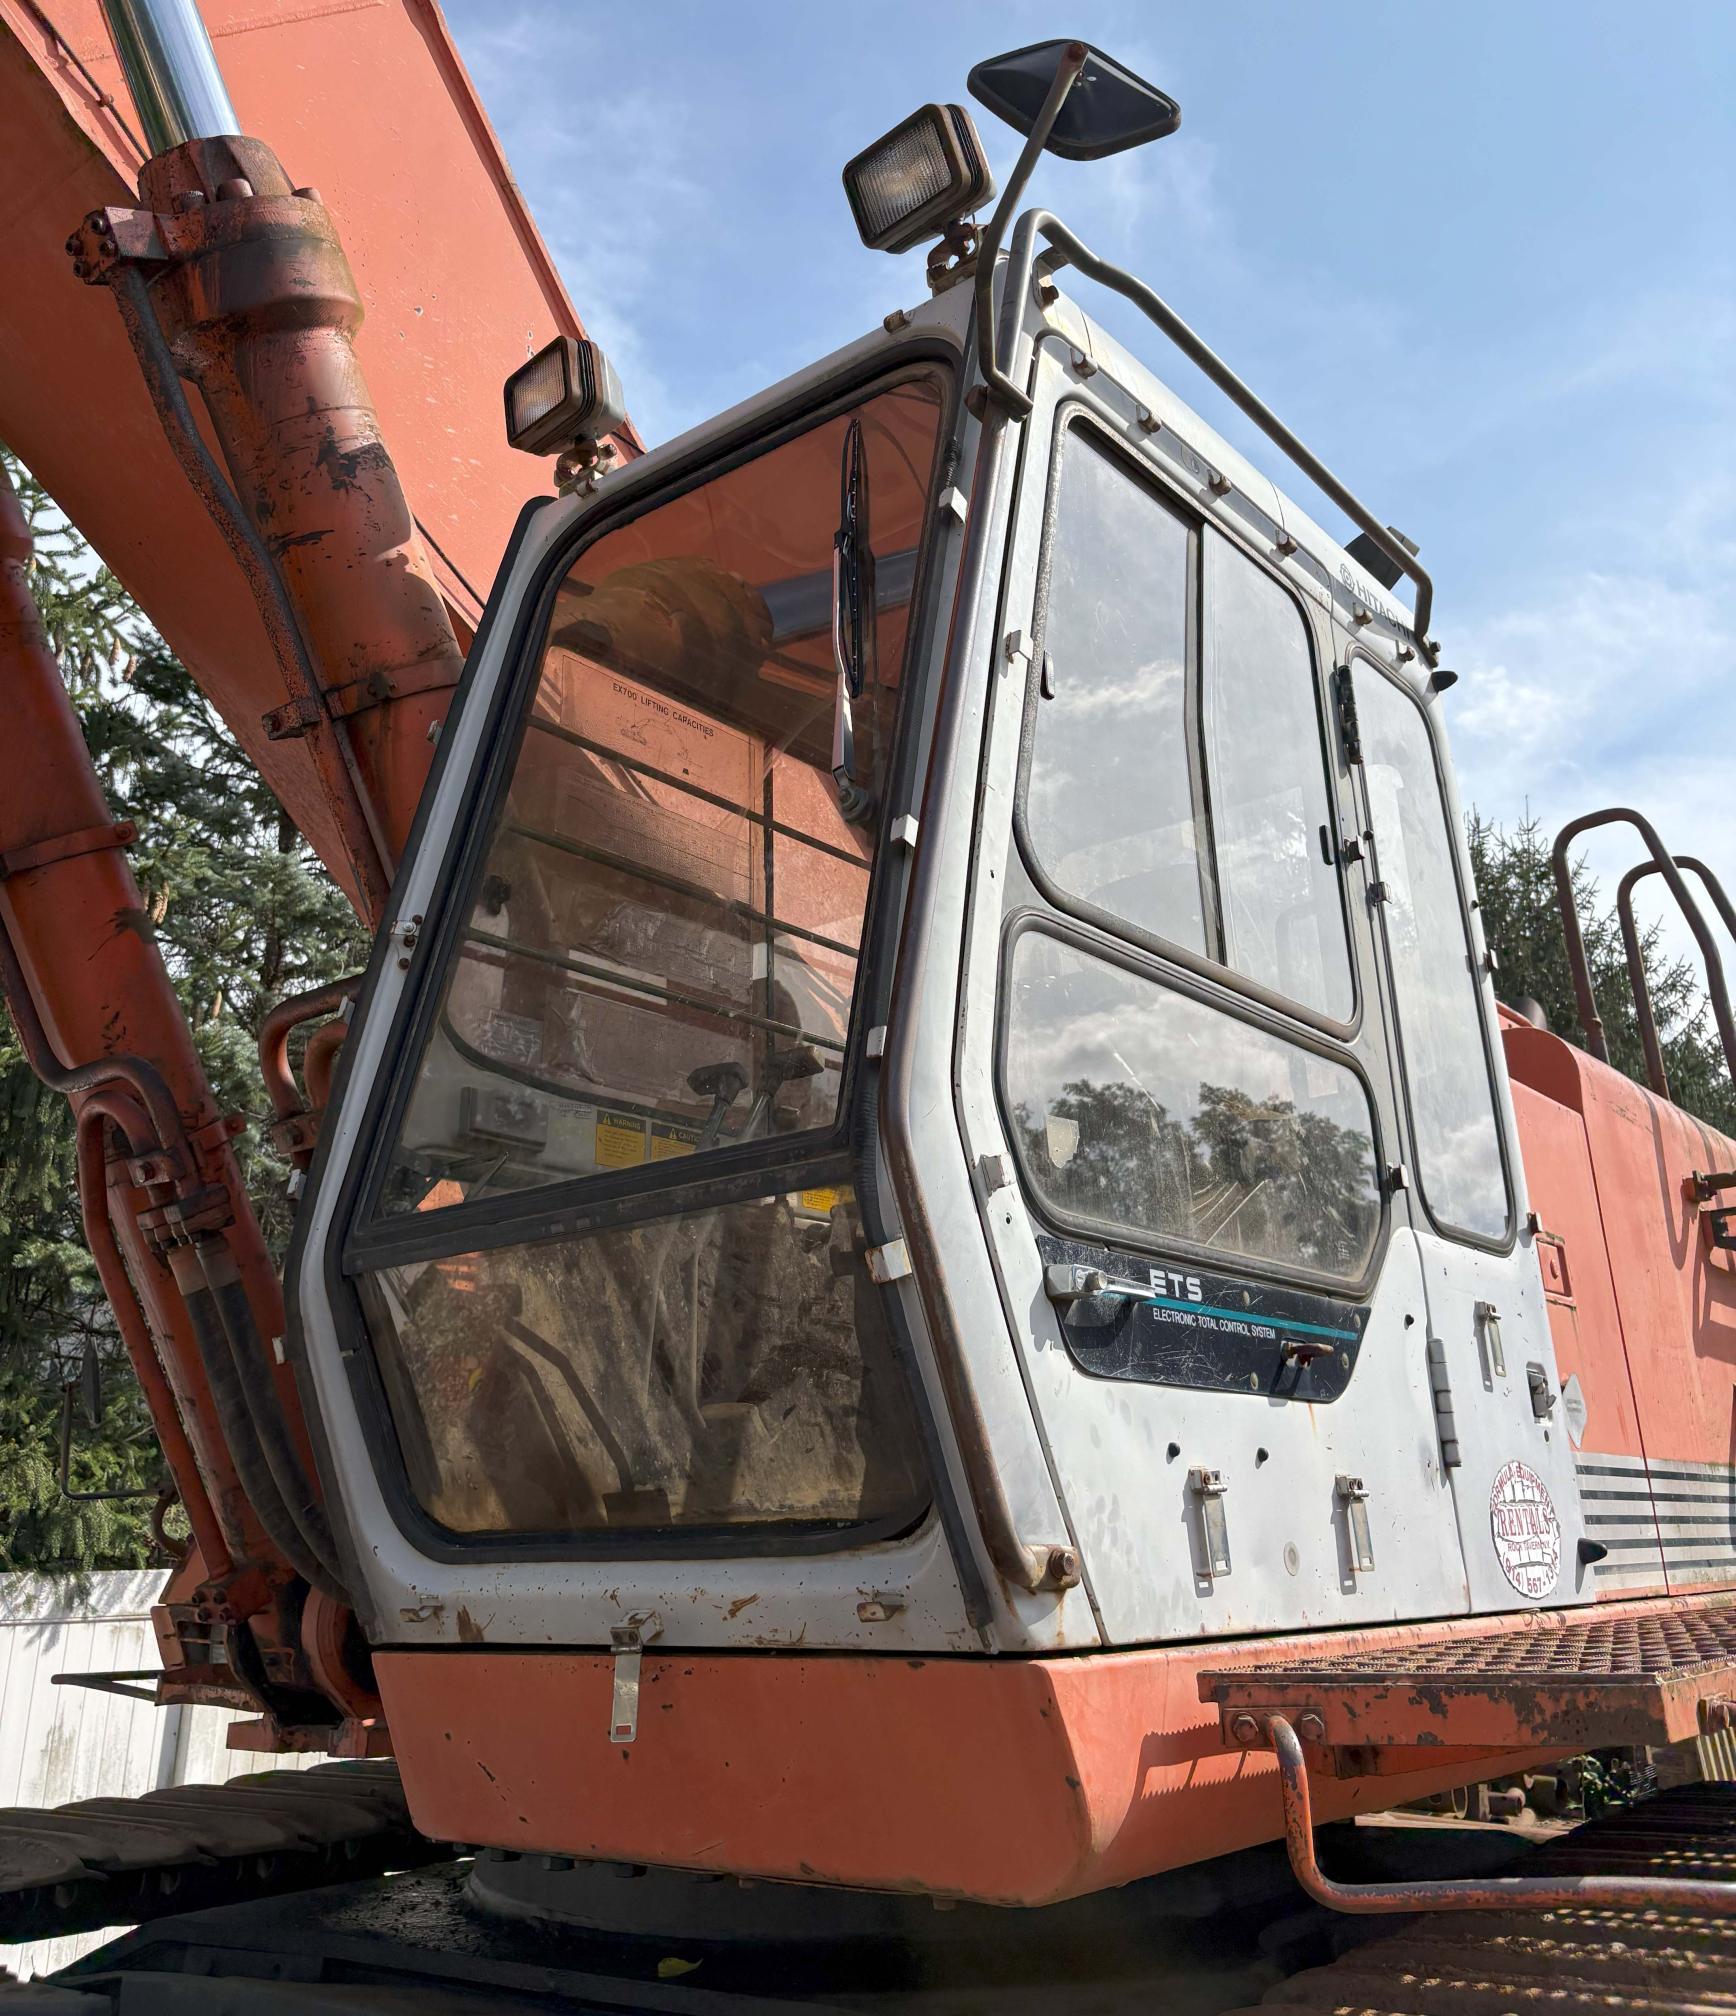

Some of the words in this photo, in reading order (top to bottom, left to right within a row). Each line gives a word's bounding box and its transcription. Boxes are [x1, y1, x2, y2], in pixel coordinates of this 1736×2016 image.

[1356, 580, 1409, 640] HITACHI
[613, 682, 638, 701] EX700
[640, 696, 669, 716] LIFTING
[672, 711, 714, 737] CAPACITIES
[613, 1117, 641, 1131] WARNING
[1150, 1268, 1203, 1302] ETS
[1153, 1307, 1197, 1327] ELECTRONIC
[1197, 1315, 1219, 1331] TOTAL
[1219, 1319, 1250, 1336] CONTROL
[1251, 1324, 1276, 1340] SYSTEM
[1492, 1463, 1514, 1517] FORMULA
[1499, 1506, 1551, 1537] RENTALS
[1507, 1542, 1523, 1552] ROCK
